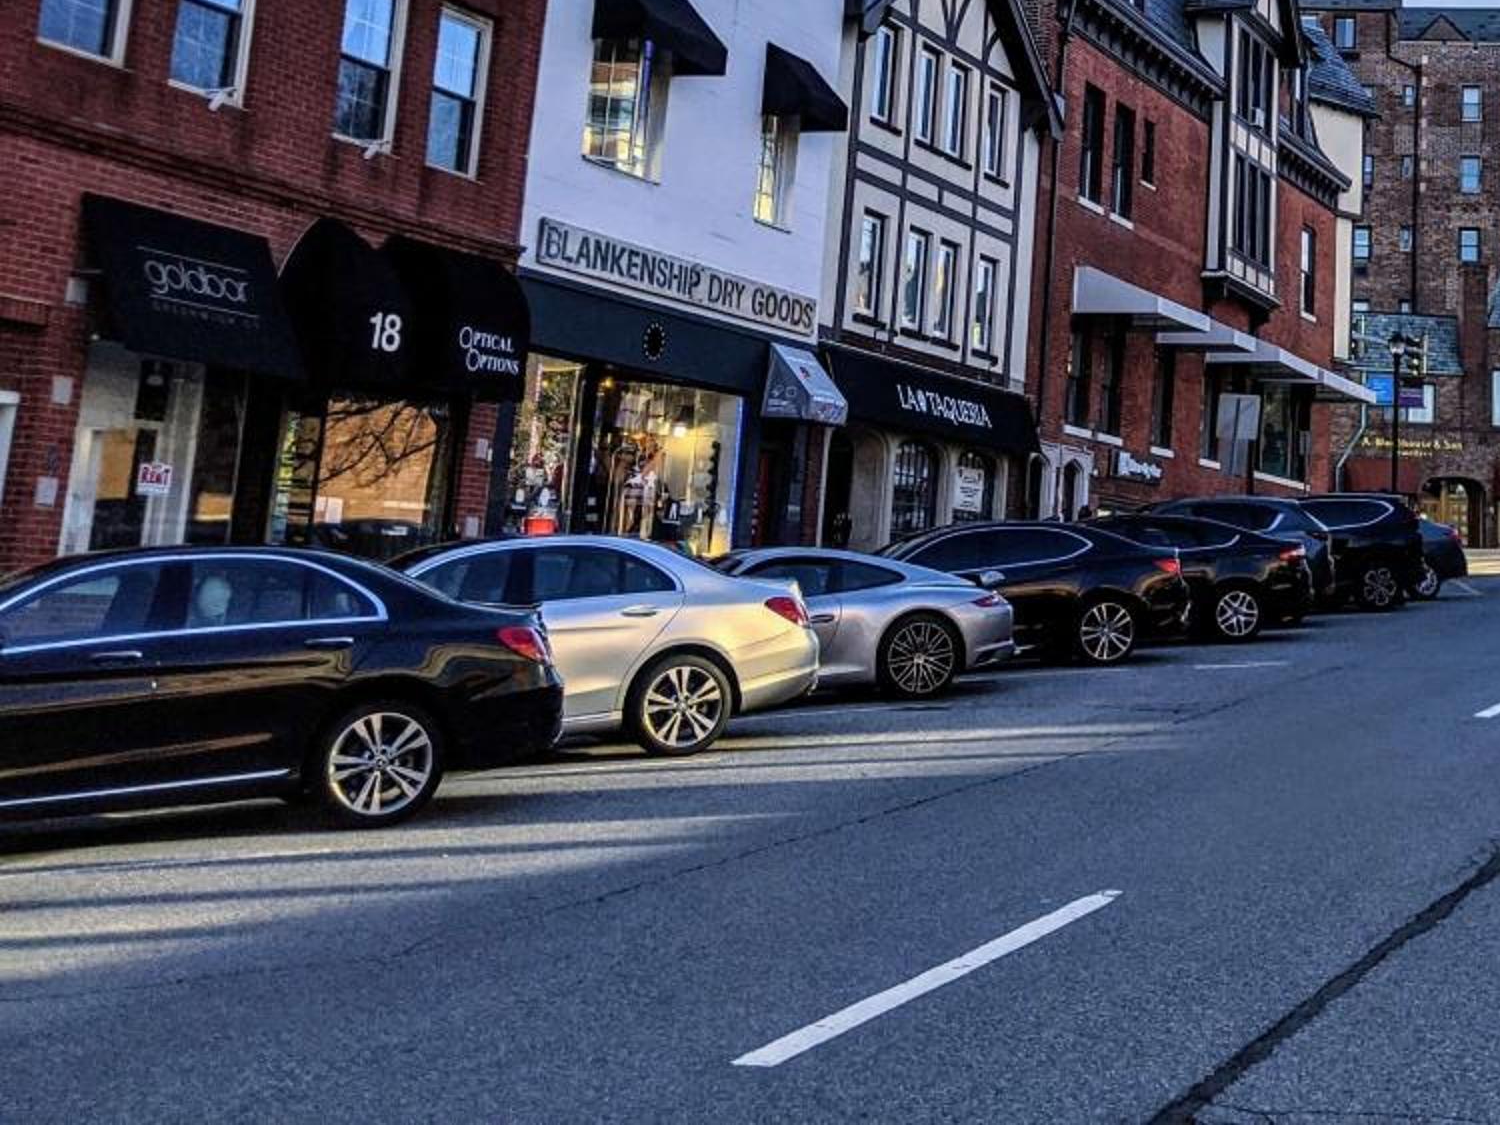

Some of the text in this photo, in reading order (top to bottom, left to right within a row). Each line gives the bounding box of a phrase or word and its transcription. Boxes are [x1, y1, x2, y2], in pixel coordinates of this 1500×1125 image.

[545, 226, 814, 327] BLANKENSHIP DRY GOODS
[369, 312, 402, 352] 18
[459, 326, 514, 353] OPTICAL
[466, 348, 520, 375] OPTIONS
